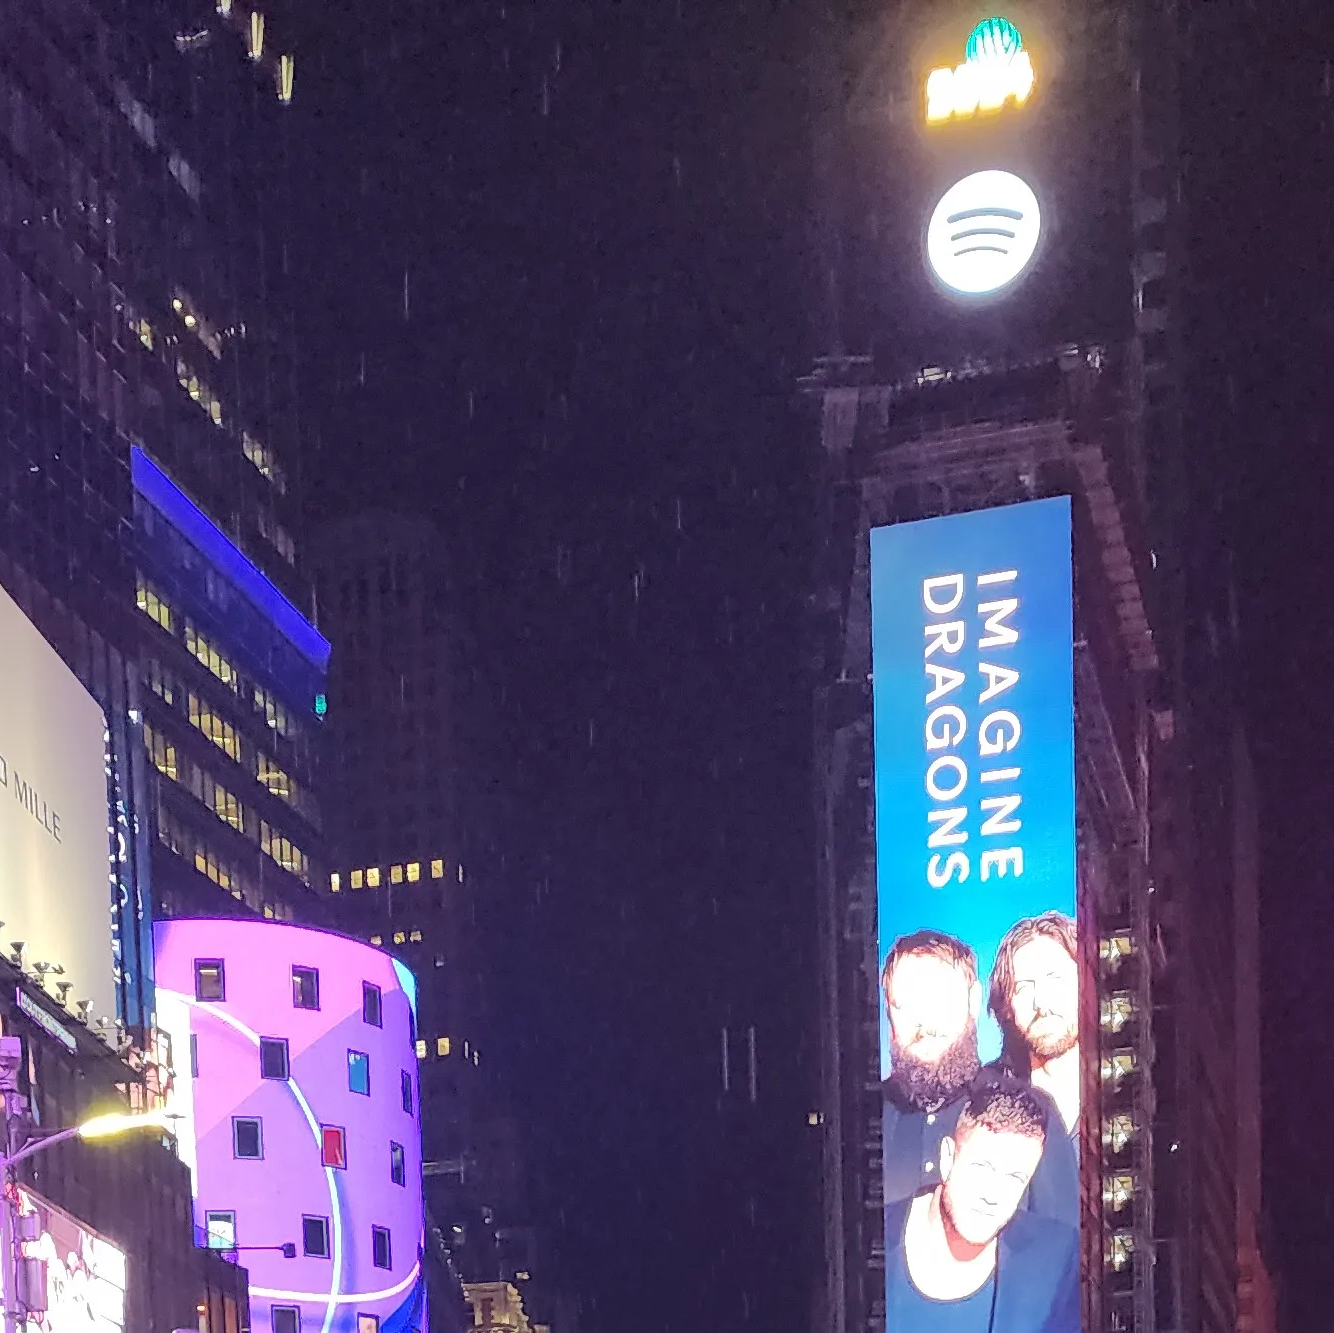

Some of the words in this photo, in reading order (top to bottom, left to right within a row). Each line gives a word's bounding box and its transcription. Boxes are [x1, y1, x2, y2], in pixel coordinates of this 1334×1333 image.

[13, 770, 63, 844] MILLE
[921, 572, 971, 890] DRAGONS
[976, 569, 1024, 883] IMAGINE
